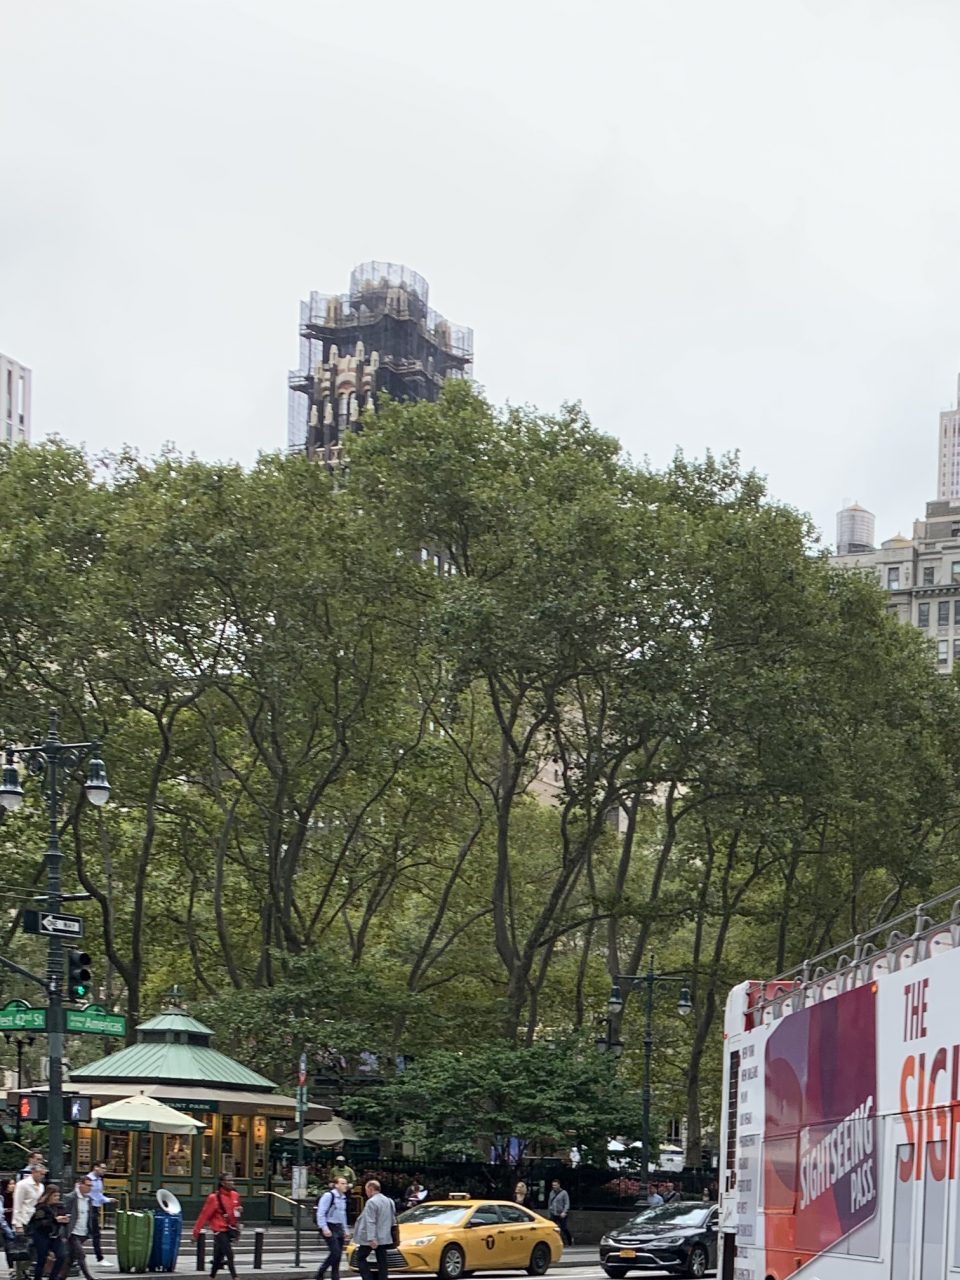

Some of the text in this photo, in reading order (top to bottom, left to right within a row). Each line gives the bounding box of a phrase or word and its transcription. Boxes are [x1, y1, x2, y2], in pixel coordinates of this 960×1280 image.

[33, 1013, 44, 1025] St
[84, 1018, 122, 1032] Americas
[903, 977, 929, 1042] THE
[800, 1095, 873, 1210] SIGHTSEEING
